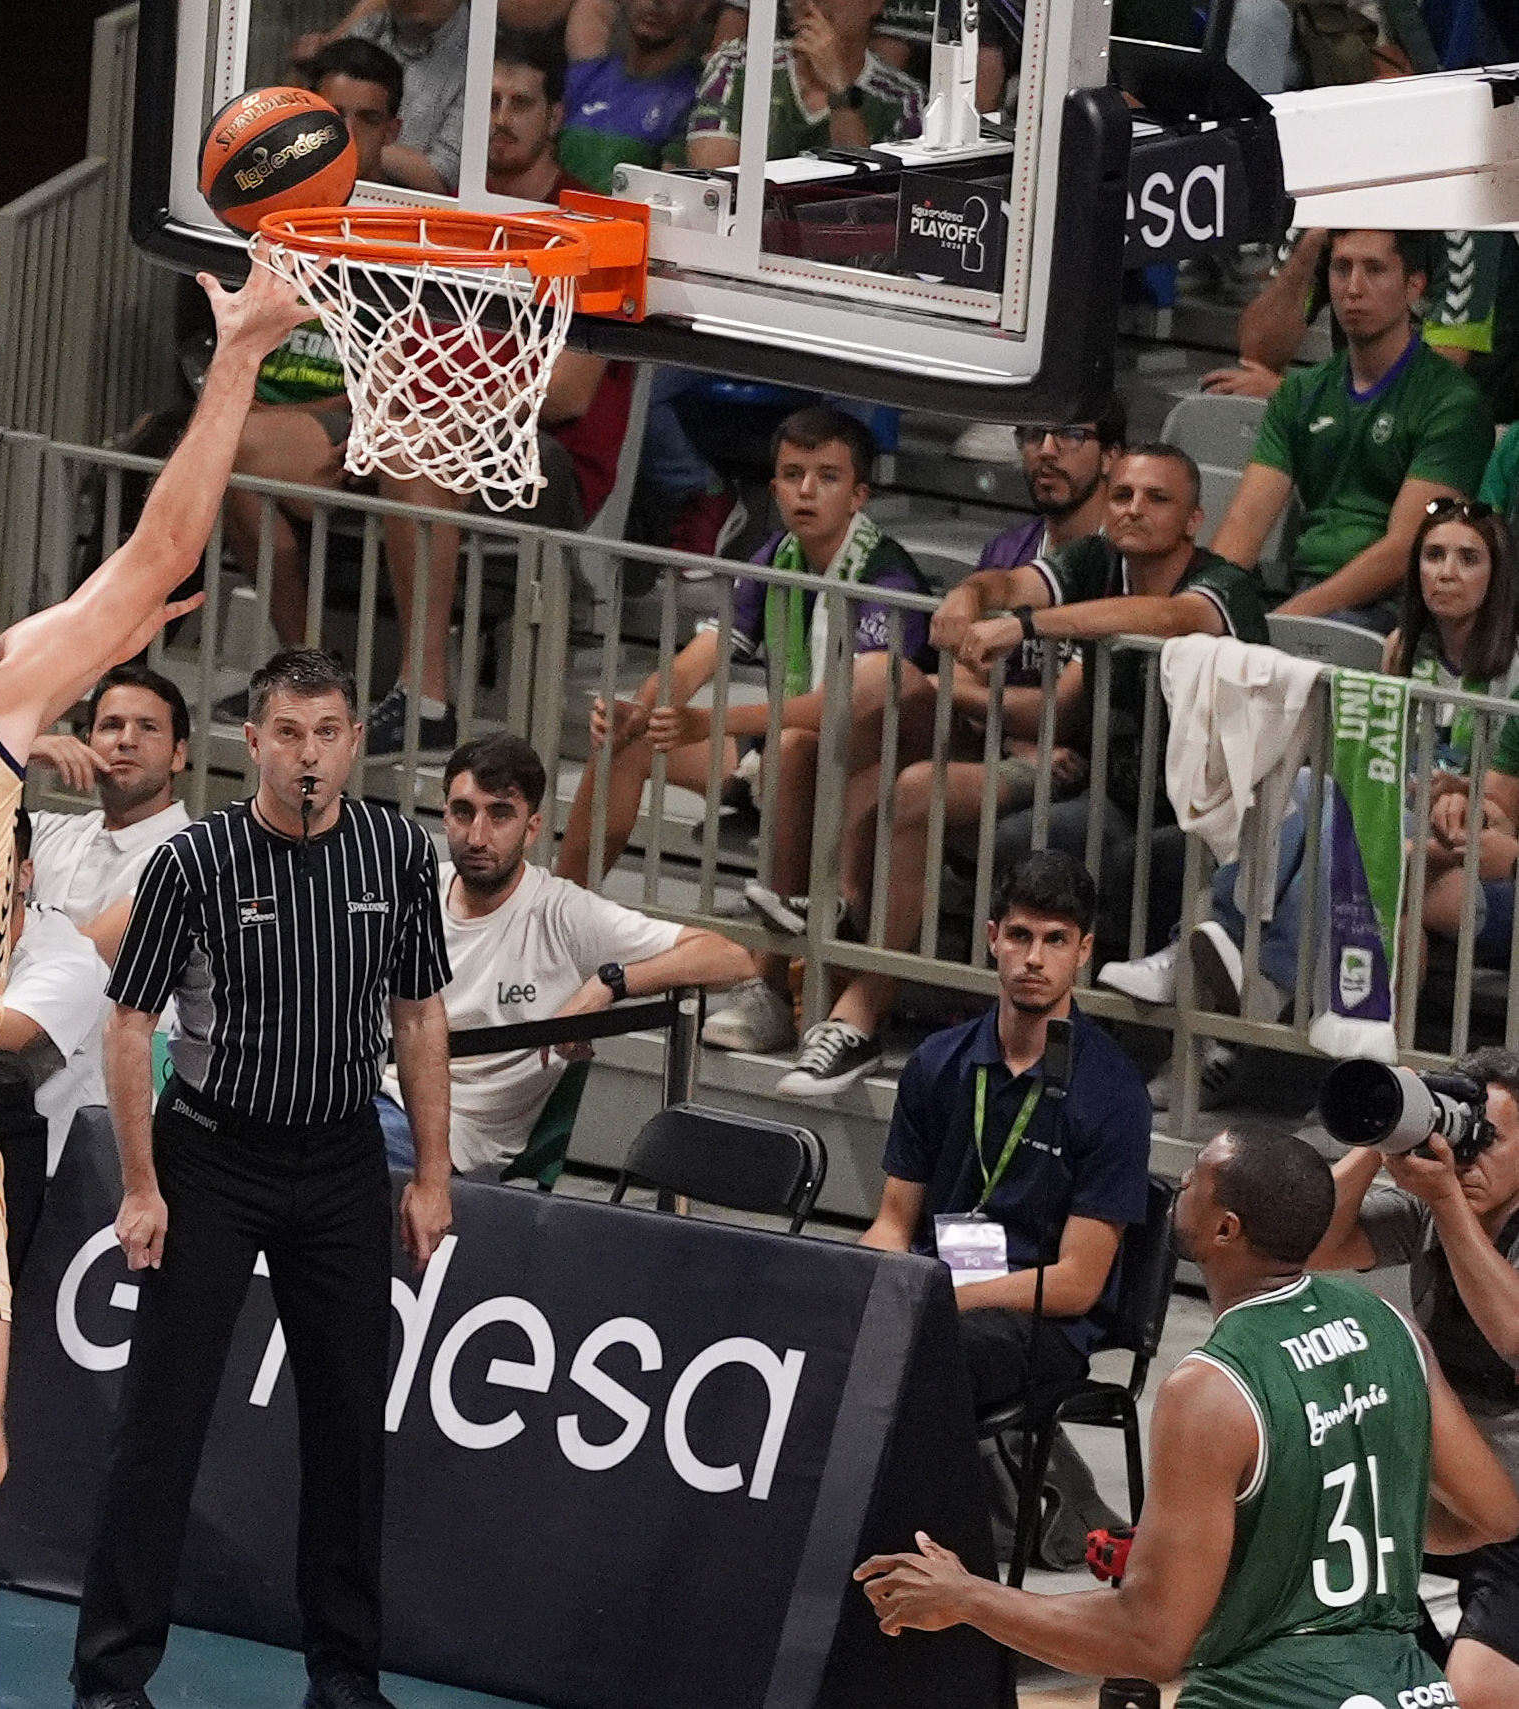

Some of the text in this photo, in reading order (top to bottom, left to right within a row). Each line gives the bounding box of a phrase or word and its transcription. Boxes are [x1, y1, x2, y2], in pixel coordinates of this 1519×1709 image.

[215, 91, 312, 153] SPALDING
[910, 217, 977, 243] PLAYOFF
[347, 901, 389, 914] SPALDING
[497, 981, 536, 1005] Lee
[171, 1098, 218, 1133] SPALDING
